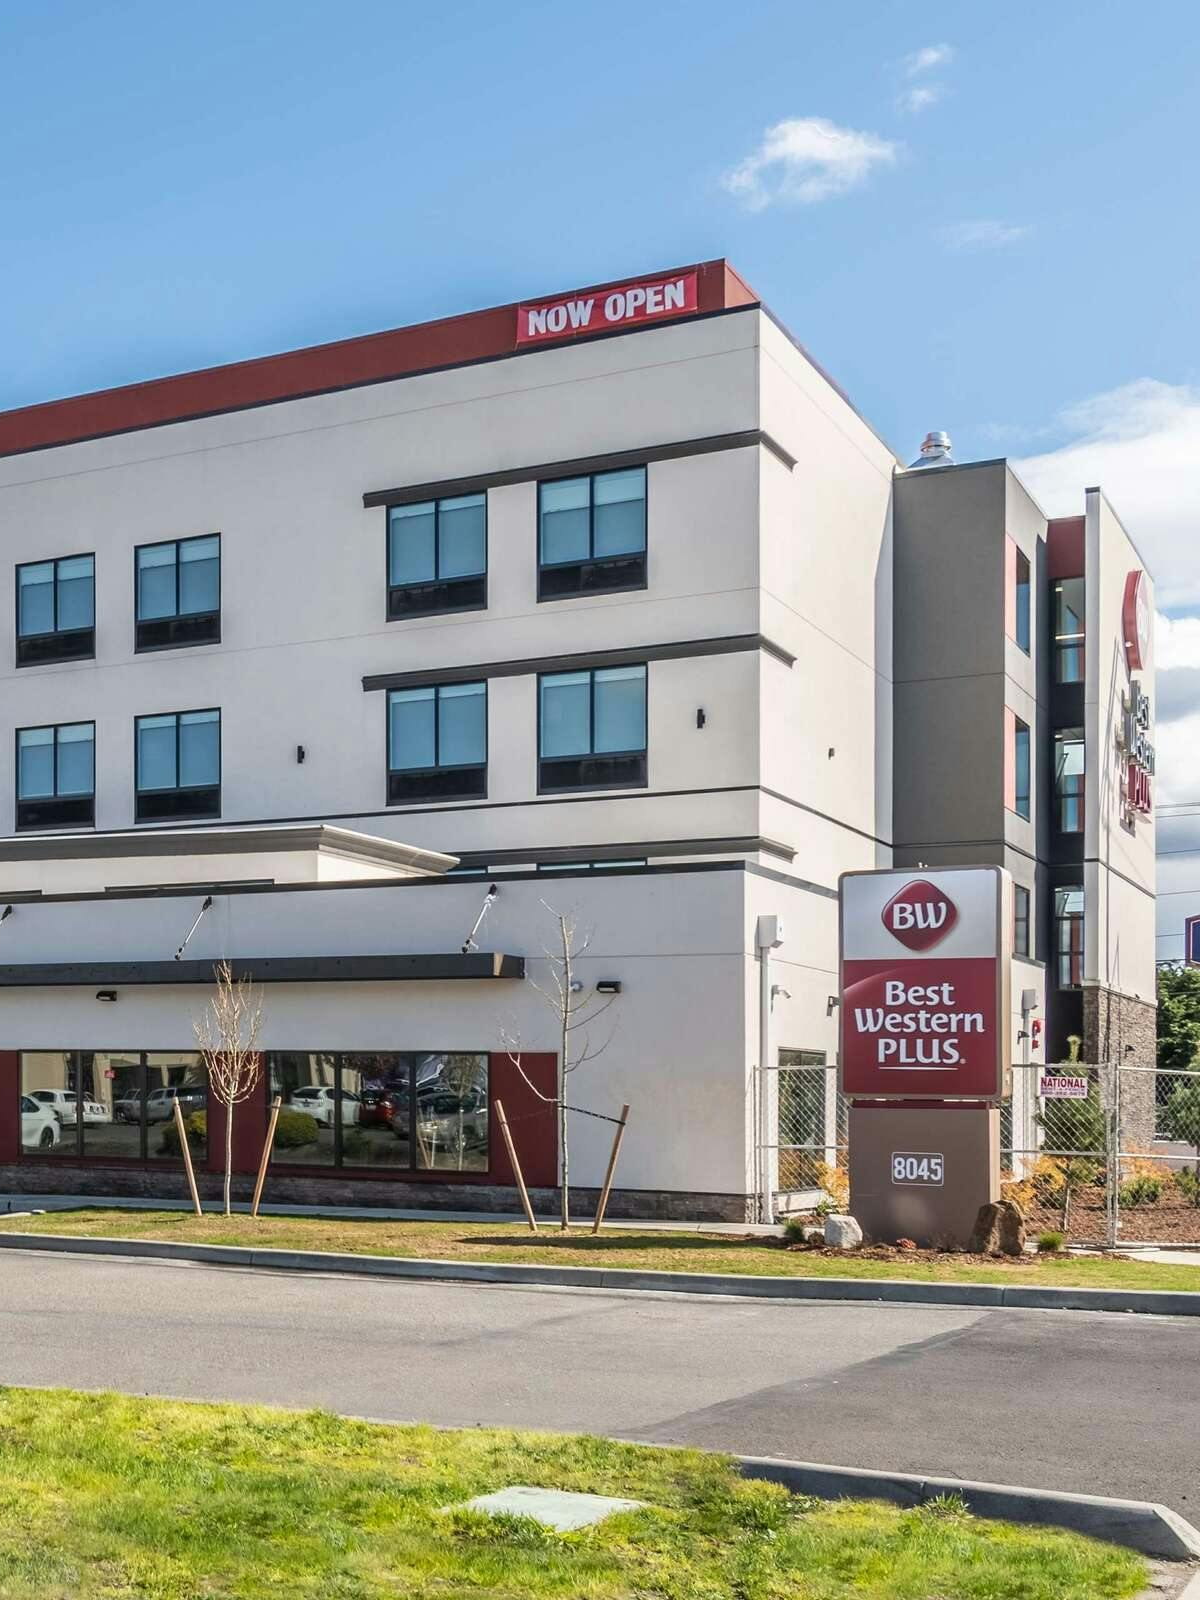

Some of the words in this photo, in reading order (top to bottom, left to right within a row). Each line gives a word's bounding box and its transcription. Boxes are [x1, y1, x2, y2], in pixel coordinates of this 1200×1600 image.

[528, 299, 595, 336] NOW
[604, 280, 685, 321] OPEN
[893, 902, 947, 930] BW
[885, 980, 956, 1006] Best
[854, 1008, 985, 1033] Western
[877, 1037, 961, 1065] PLUS
[1041, 1077, 1085, 1088] NATIONAL
[894, 1157, 942, 1181] 8045
